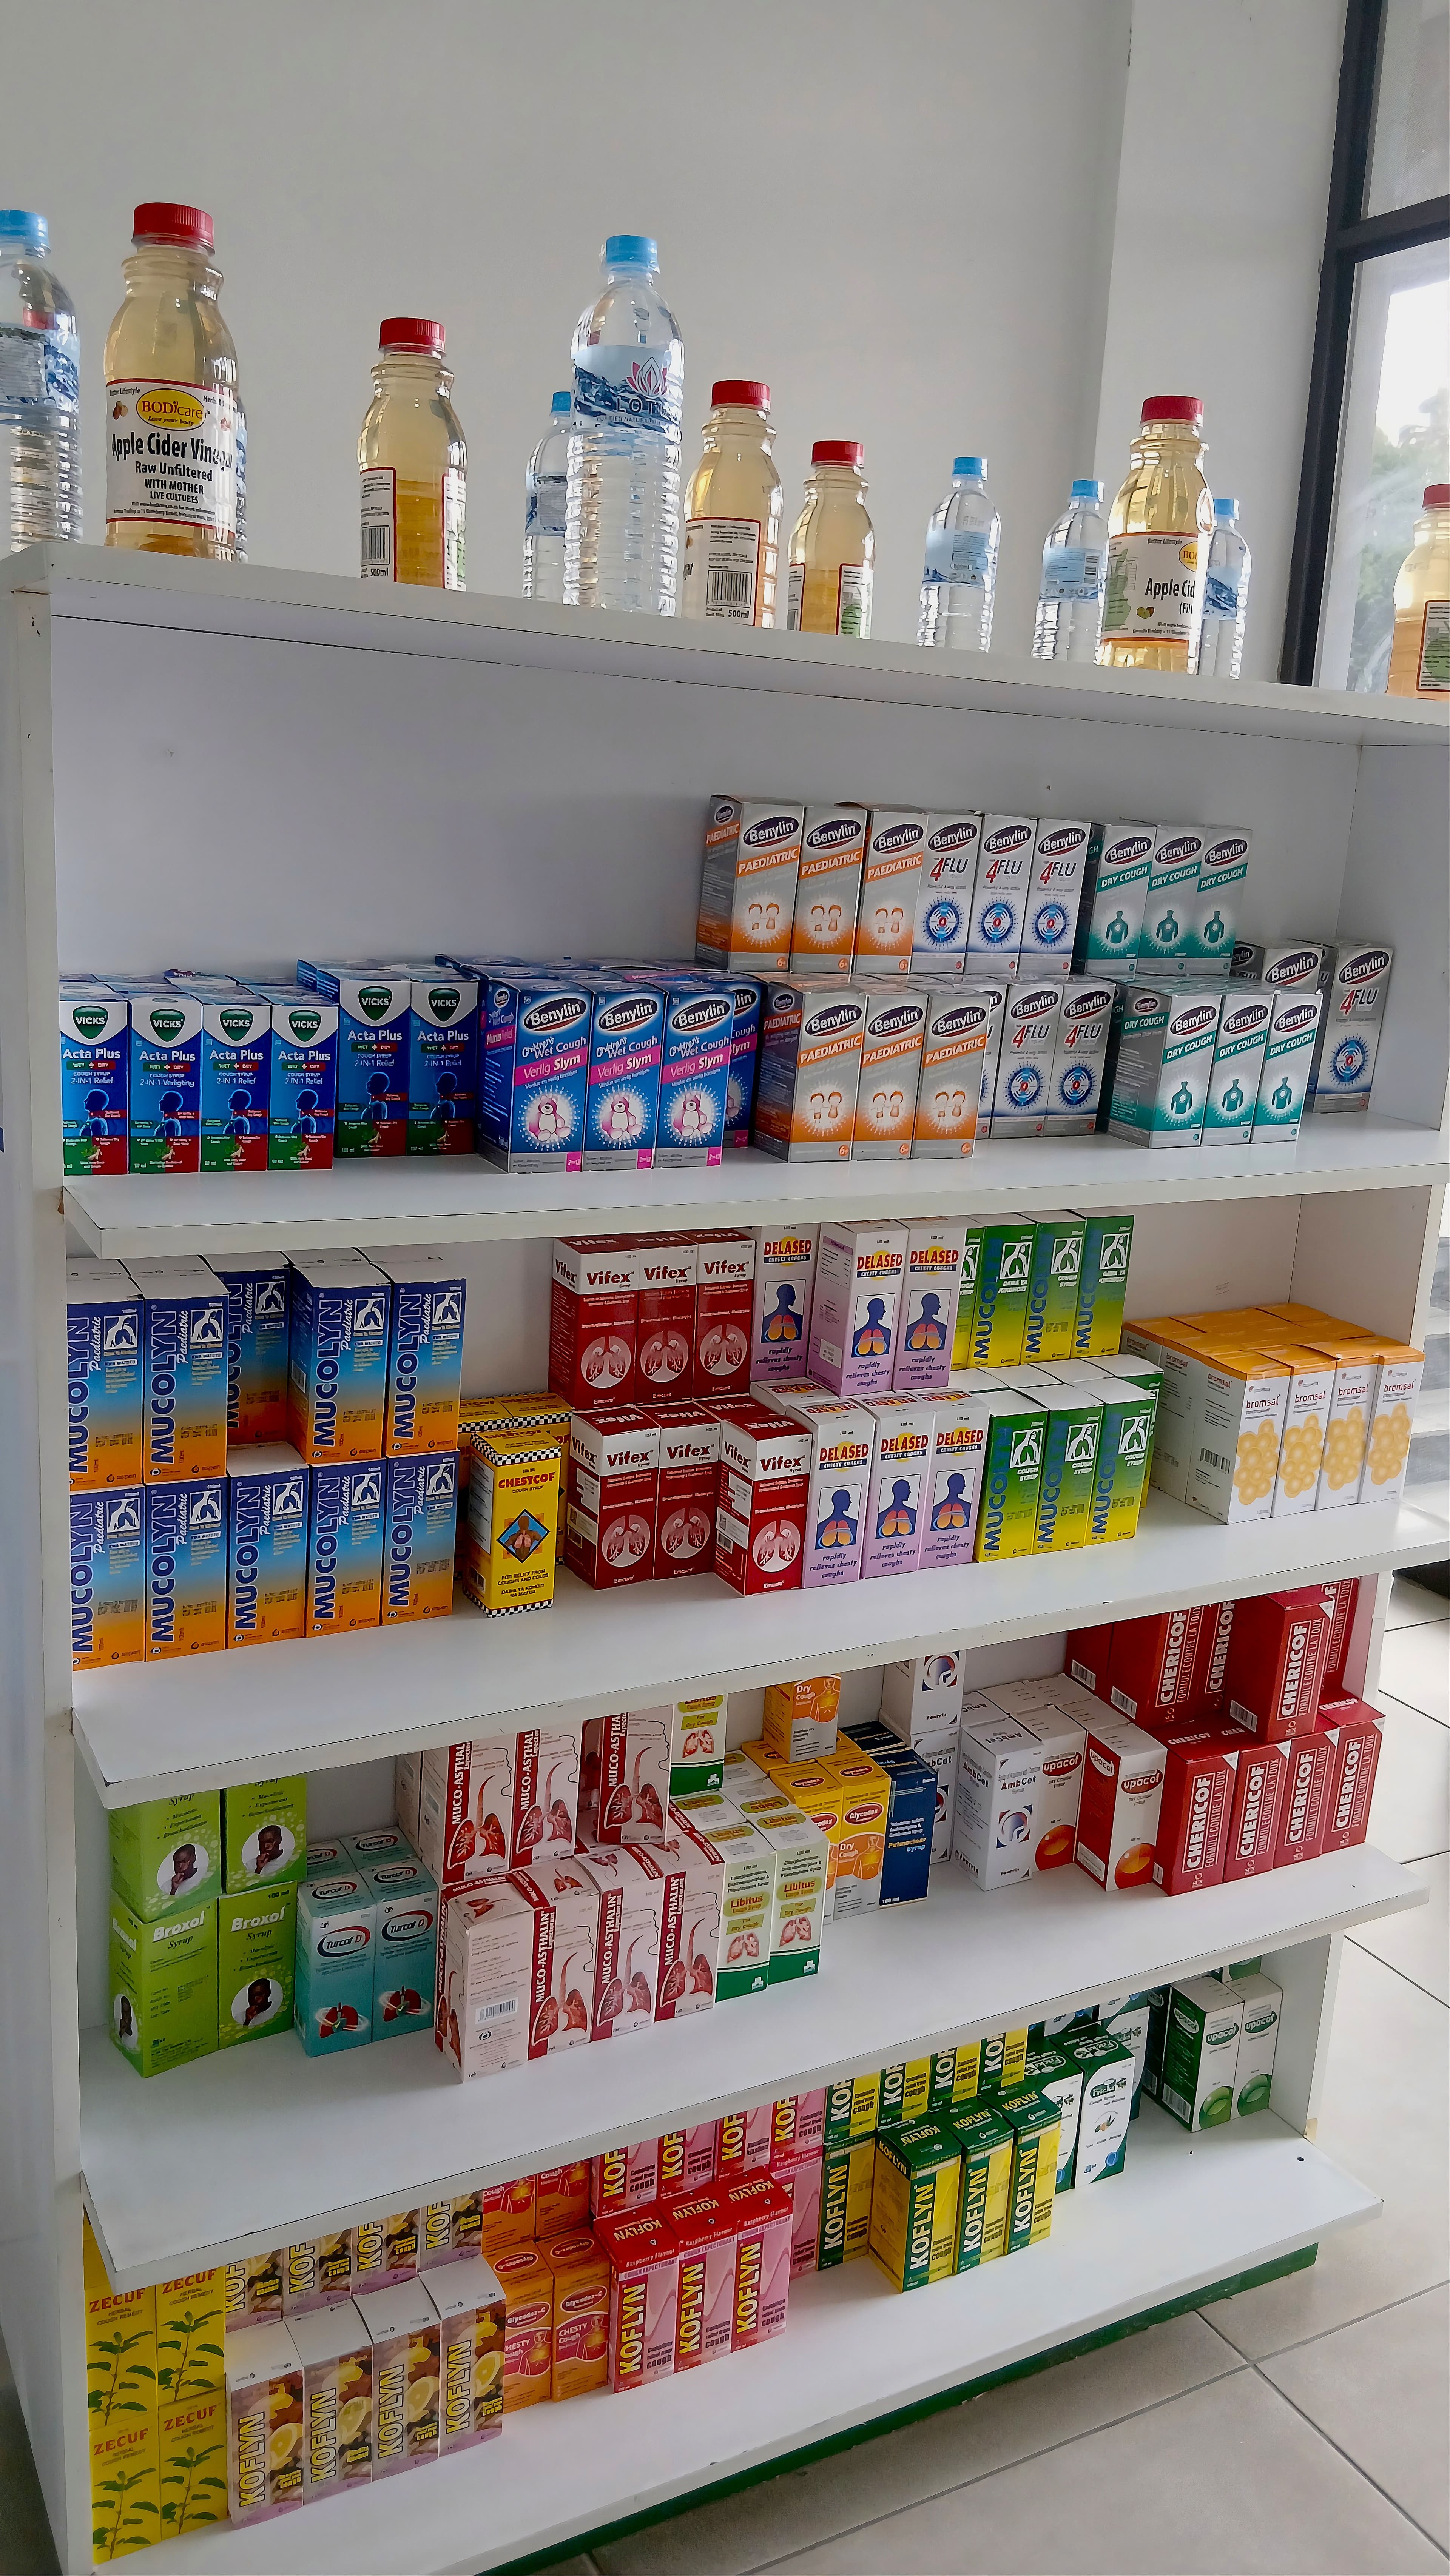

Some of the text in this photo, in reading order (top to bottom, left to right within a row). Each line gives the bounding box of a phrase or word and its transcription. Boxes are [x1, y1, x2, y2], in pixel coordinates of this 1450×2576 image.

[113, 432, 187, 461] Apple Cider
[135, 461, 212, 481] Raw Unfiltered
[145, 479, 204, 494] WITH MOTHER
[166, 493, 198, 503] CULTURES
[1145, 578, 1179, 600] Apple
[728, 610, 749, 618] 500ml
[750, 820, 793, 843] Benylin
[812, 823, 856, 845] Benylin
[879, 827, 919, 848] Benylin
[933, 827, 972, 847] Benylin
[989, 830, 1027, 849] Benylin
[1043, 832, 1081, 851] Benylin
[1110, 840, 1148, 860] Benylin
[1160, 840, 1197, 859] Benylin
[1209, 843, 1244, 861] Benylin
[739, 848, 798, 874] PAEDIATRIC
[802, 851, 861, 875] PAEDIATRIC
[867, 855, 922, 879] PAEDIATRIC
[1101, 866, 1148, 888] DRY COUGH
[1152, 866, 1197, 887] DRY COUGH
[1201, 867, 1243, 888] DRY COUGH
[531, 1004, 580, 1025] Benylin
[605, 1004, 652, 1025] Benylin
[678, 1004, 724, 1025] Benylin
[811, 1009, 856, 1030] Benylin
[875, 1011, 918, 1031] Benylin
[1139, 1016, 1164, 1027] COUGH
[347, 1030, 402, 1041] Acta Plus
[417, 1031, 469, 1041] Acta Plus
[1219, 1034, 1263, 1057] DRY COUGH
[1270, 1032, 1312, 1056] DRY COUGH
[63, 1048, 120, 1059] Acta Plus
[139, 1051, 195, 1061] Acta Plus
[210, 1050, 263, 1060] Acta Plus
[279, 1050, 330, 1061] Acta Plus
[535, 1036, 586, 1057] Wet Cough
[608, 1036, 657, 1058] Wet Cough
[681, 1035, 729, 1058] Wet Cough
[801, 1036, 861, 1064] PAEDIATRIC
[863, 1036, 921, 1064] PAEDIATRIC
[926, 1037, 984, 1064] PAEDIATRIC
[1166, 1035, 1212, 1060] DRY COUGH
[524, 1055, 580, 1079] Verlig Slym
[598, 1054, 652, 1078] Verlig Slym
[671, 1054, 723, 1077] Verlig Slym
[764, 1239, 812, 1255] DELASED
[910, 1249, 959, 1264] DELASED
[703, 1262, 746, 1275] Vifex
[857, 1254, 902, 1270] DELASED
[586, 1272, 631, 1285] Vifex
[644, 1267, 688, 1280] Vifex
[313, 1300, 342, 1447] MUCOLYN
[393, 1294, 421, 1438] MUCOLYN
[151, 1311, 176, 1464] MUCOLYN
[1295, 1389, 1328, 1403] bromsal
[1338, 1383, 1369, 1396] bromsal
[1384, 1380, 1415, 1393] bromsal
[1246, 1394, 1280, 1409] bromsal
[881, 1435, 928, 1452] DELASED
[937, 1430, 983, 1446] DELASED
[572, 1437, 597, 1463] Vifex
[607, 1450, 650, 1467] Vifex
[666, 1445, 711, 1459] Vifex
[820, 1444, 868, 1461] DELASED
[760, 1457, 802, 1471] Vifex
[498, 1471, 555, 1489] CHESTCOF
[389, 1467, 415, 1606] MUCOLYN
[236, 1487, 260, 1629] MUCOLYN
[314, 1477, 340, 1619] MUCOLYN
[70, 1503, 93, 1652] MUCOLYN
[151, 1494, 176, 1642] MUCOLYN
[1210, 1601, 1235, 1689] CHERICOF
[1161, 1613, 1186, 1702] CHERICOF
[1282, 1625, 1307, 1715] CHERICOF
[1044, 1757, 1079, 1772] upacof
[1124, 1773, 1159, 1790] upacof
[1215, 1770, 1226, 1790] TOUX
[1336, 1742, 1361, 1828] CHERICOF
[1214, 1791, 1222, 1802] LA
[1289, 1754, 1313, 1842] CHERICOF
[1210, 1803, 1222, 1831] CONTRE
[1241, 1766, 1265, 1856] CHERICOF
[1187, 1778, 1212, 1869] CHERICOF
[784, 1881, 815, 1892] Libitus
[731, 1896, 763, 1909] Libitus
[153, 1912, 204, 1942] Broxol
[231, 1906, 285, 1932] Broxol
[168, 1935, 194, 1949] Syrup
[541, 2168, 562, 2179] Cough
[824, 2165, 847, 2250] KOFLYN
[963, 2166, 987, 2254] KOFLYN
[911, 2183, 934, 2269] KOFLYN
[162, 2270, 217, 2294] ZECUF
[736, 2242, 761, 2333] KOFLYN
[89, 2288, 145, 2313] ZECUF
[680, 2262, 704, 2354] KOFLYN
[559, 2322, 587, 2337] CHESTY
[620, 2284, 645, 2375] KOFLYN
[446, 2340, 472, 2433] KOFLYN
[164, 2406, 217, 2431] ZECUF
[378, 2364, 404, 2459] KOFLYN
[94, 2428, 148, 2456] ZECUF
[310, 2388, 336, 2483] KOFLYN
[240, 2411, 265, 2507] KOFLYN
